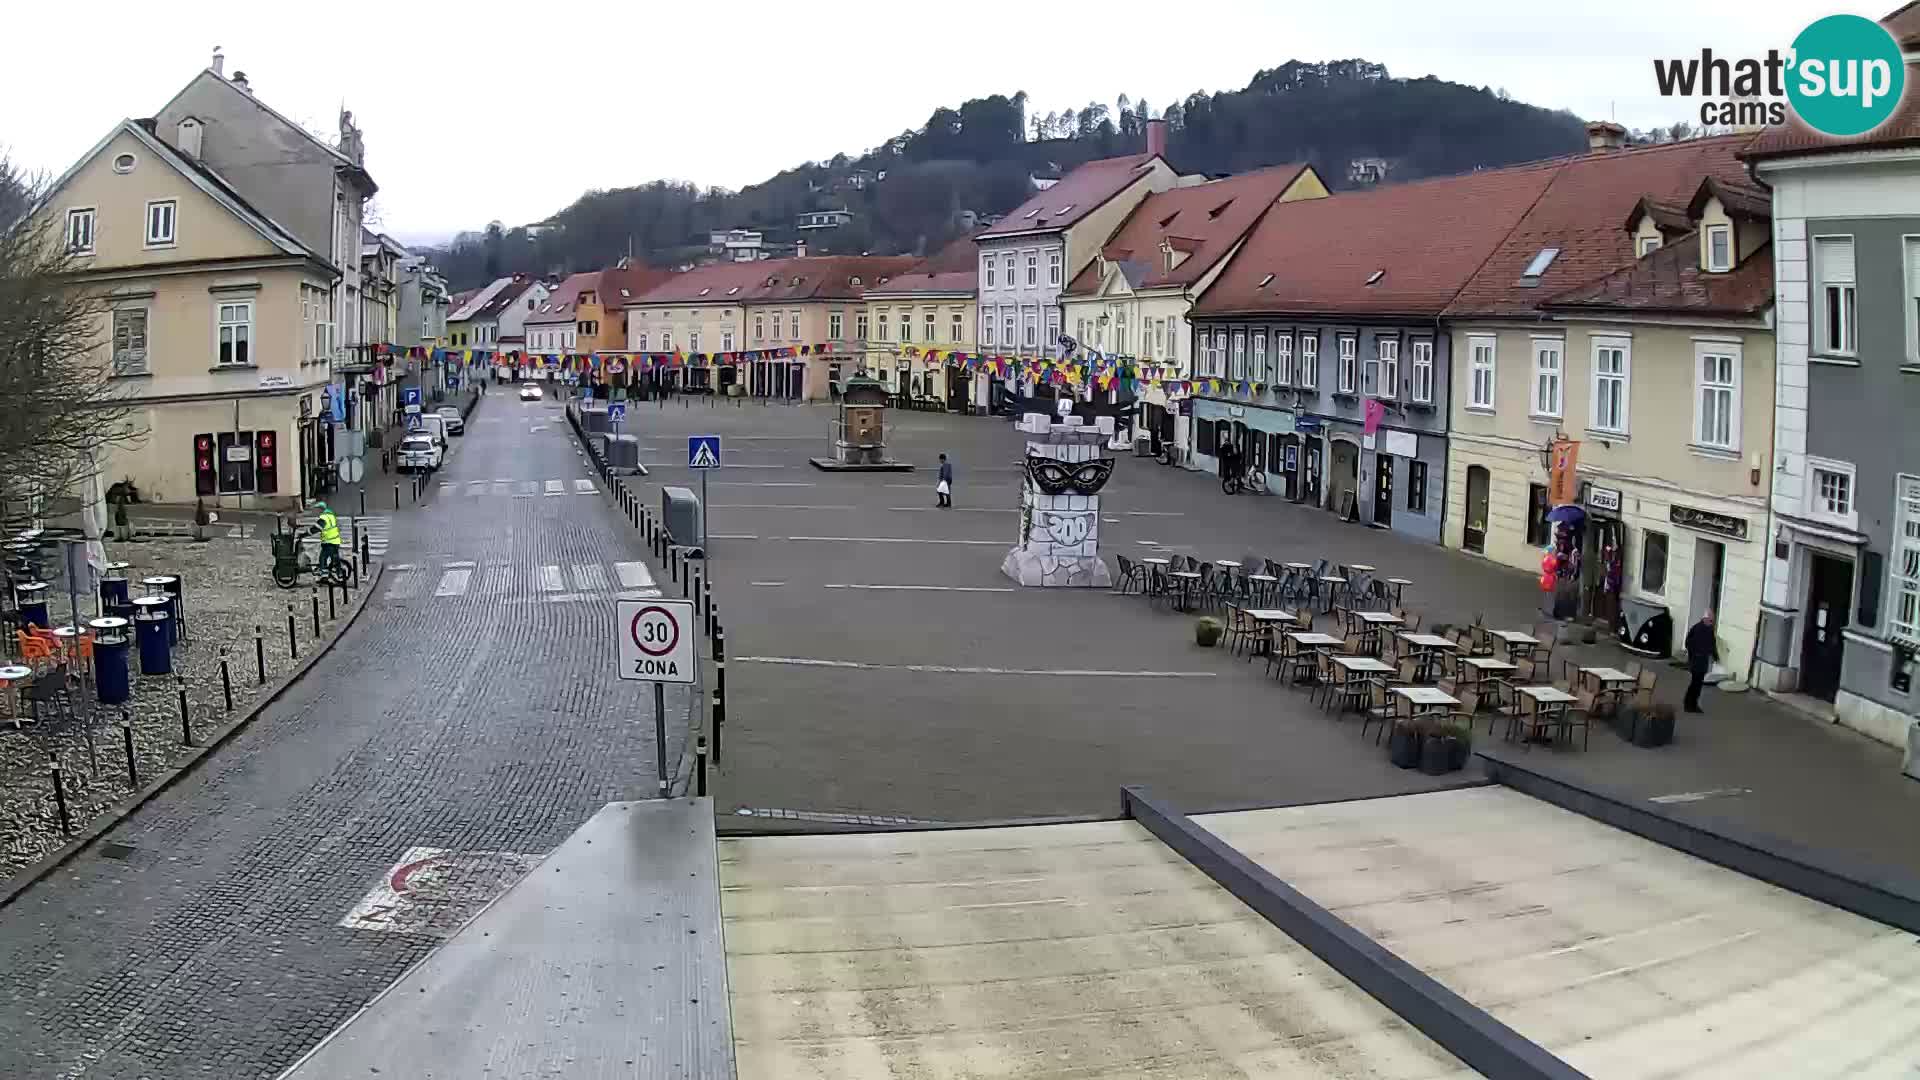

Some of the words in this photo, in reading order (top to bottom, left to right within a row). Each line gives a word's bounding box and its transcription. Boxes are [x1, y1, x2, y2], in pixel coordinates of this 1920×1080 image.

[409, 391, 417, 403] P
[1049, 516, 1088, 544] 200
[644, 622, 668, 643] 30
[634, 659, 679, 676] ZONA
